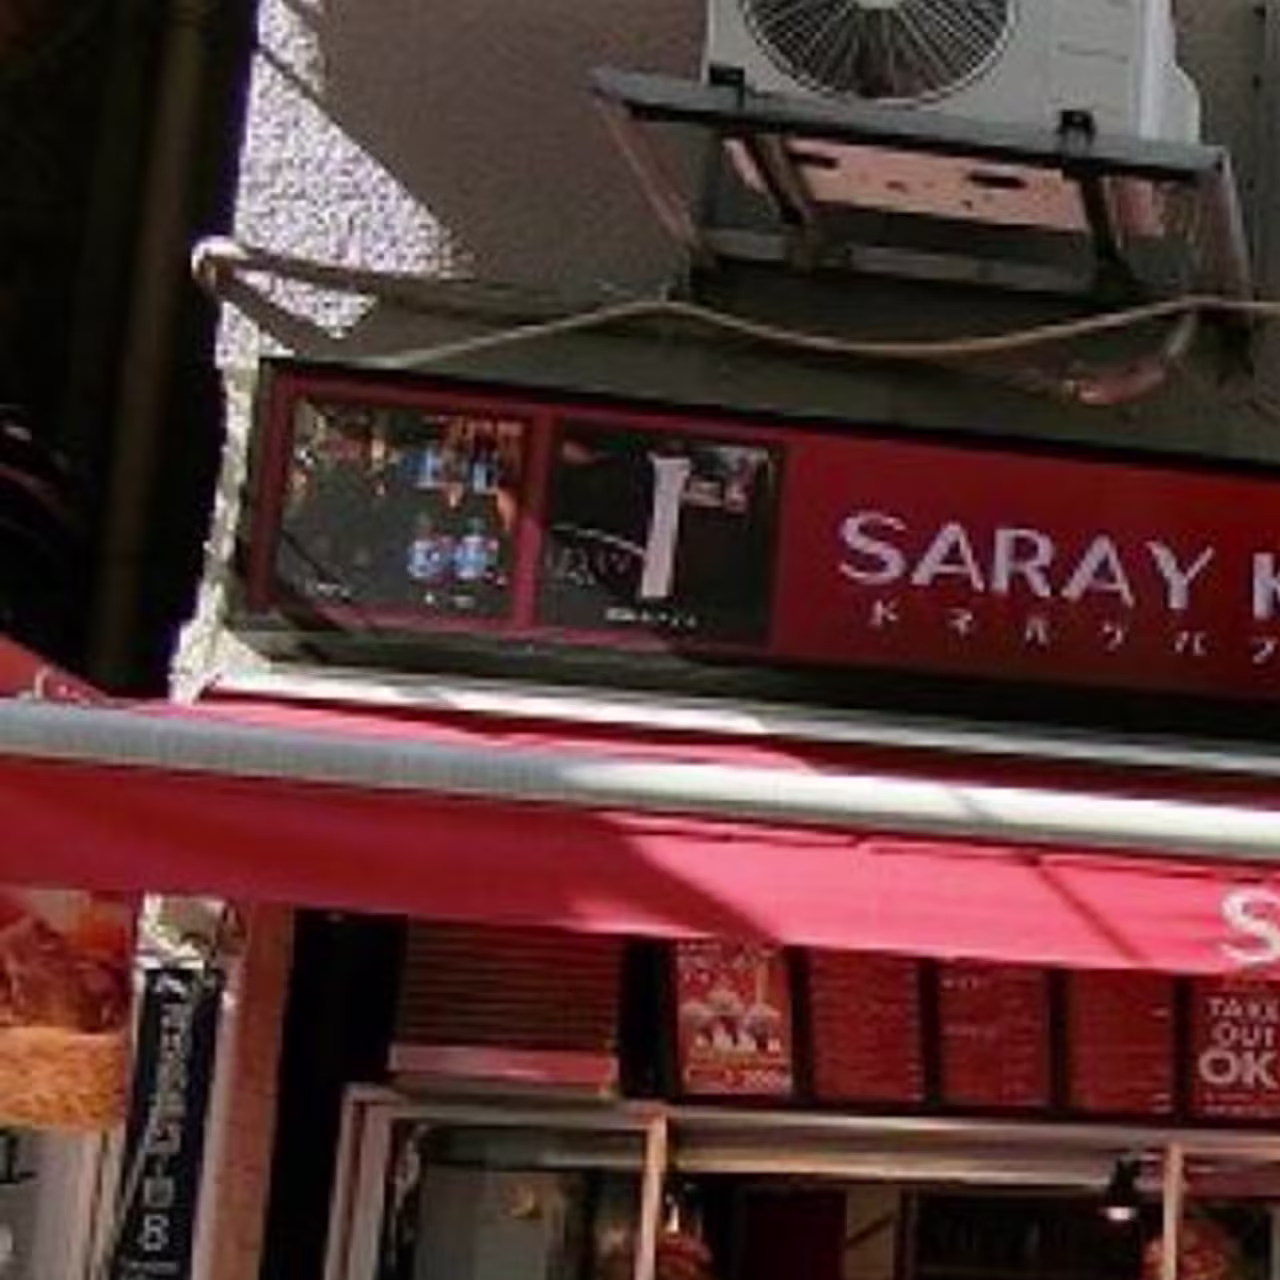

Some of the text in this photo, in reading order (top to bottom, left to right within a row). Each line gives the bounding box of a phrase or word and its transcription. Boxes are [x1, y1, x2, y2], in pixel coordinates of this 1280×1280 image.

[838, 511, 1214, 611] SARAY
[1212, 1022, 1277, 1049] OUT
[1197, 1048, 1279, 1089] OK
